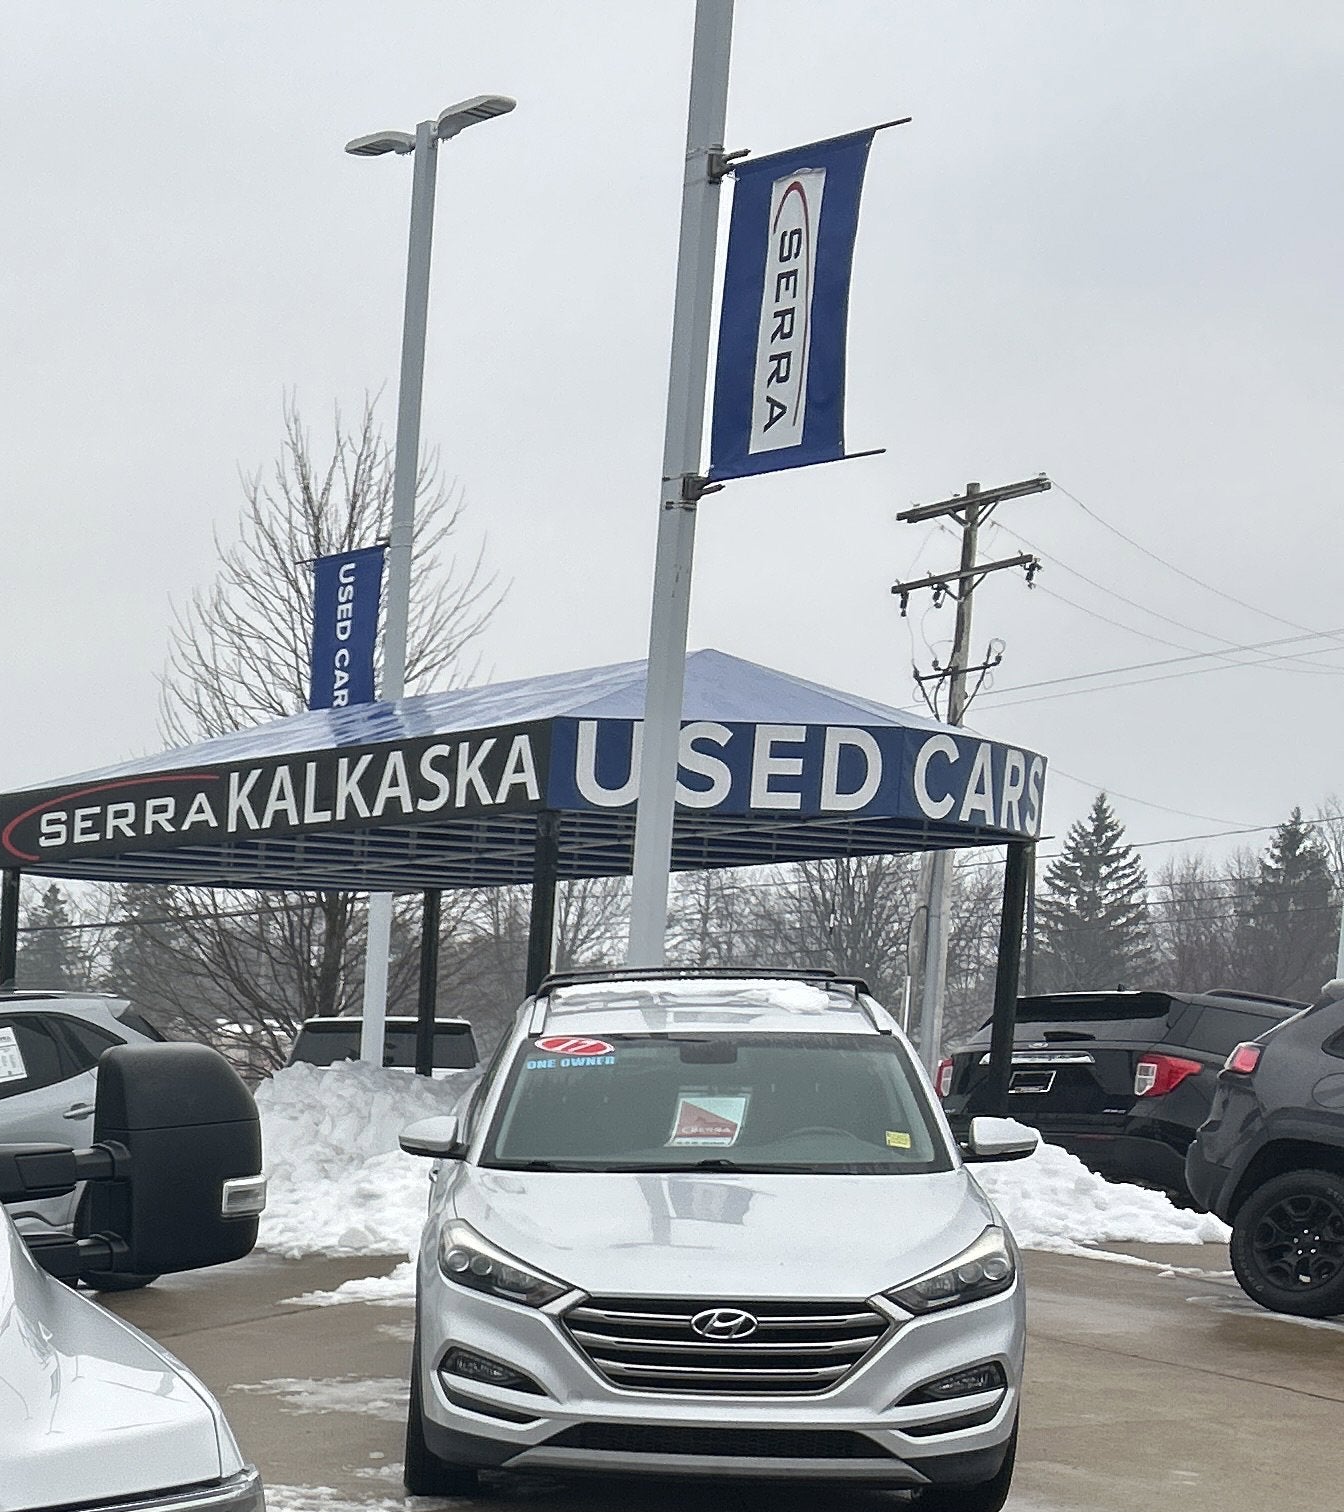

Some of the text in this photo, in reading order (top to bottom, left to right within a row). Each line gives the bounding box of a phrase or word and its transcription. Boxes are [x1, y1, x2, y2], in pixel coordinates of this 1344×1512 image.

[762, 226, 802, 433] SERRA
[333, 561, 357, 642] USED
[37, 733, 542, 848] SERRA KALKASKA
[574, 718, 1047, 838] USED CARS
[526, 1058, 557, 1070] ONE
